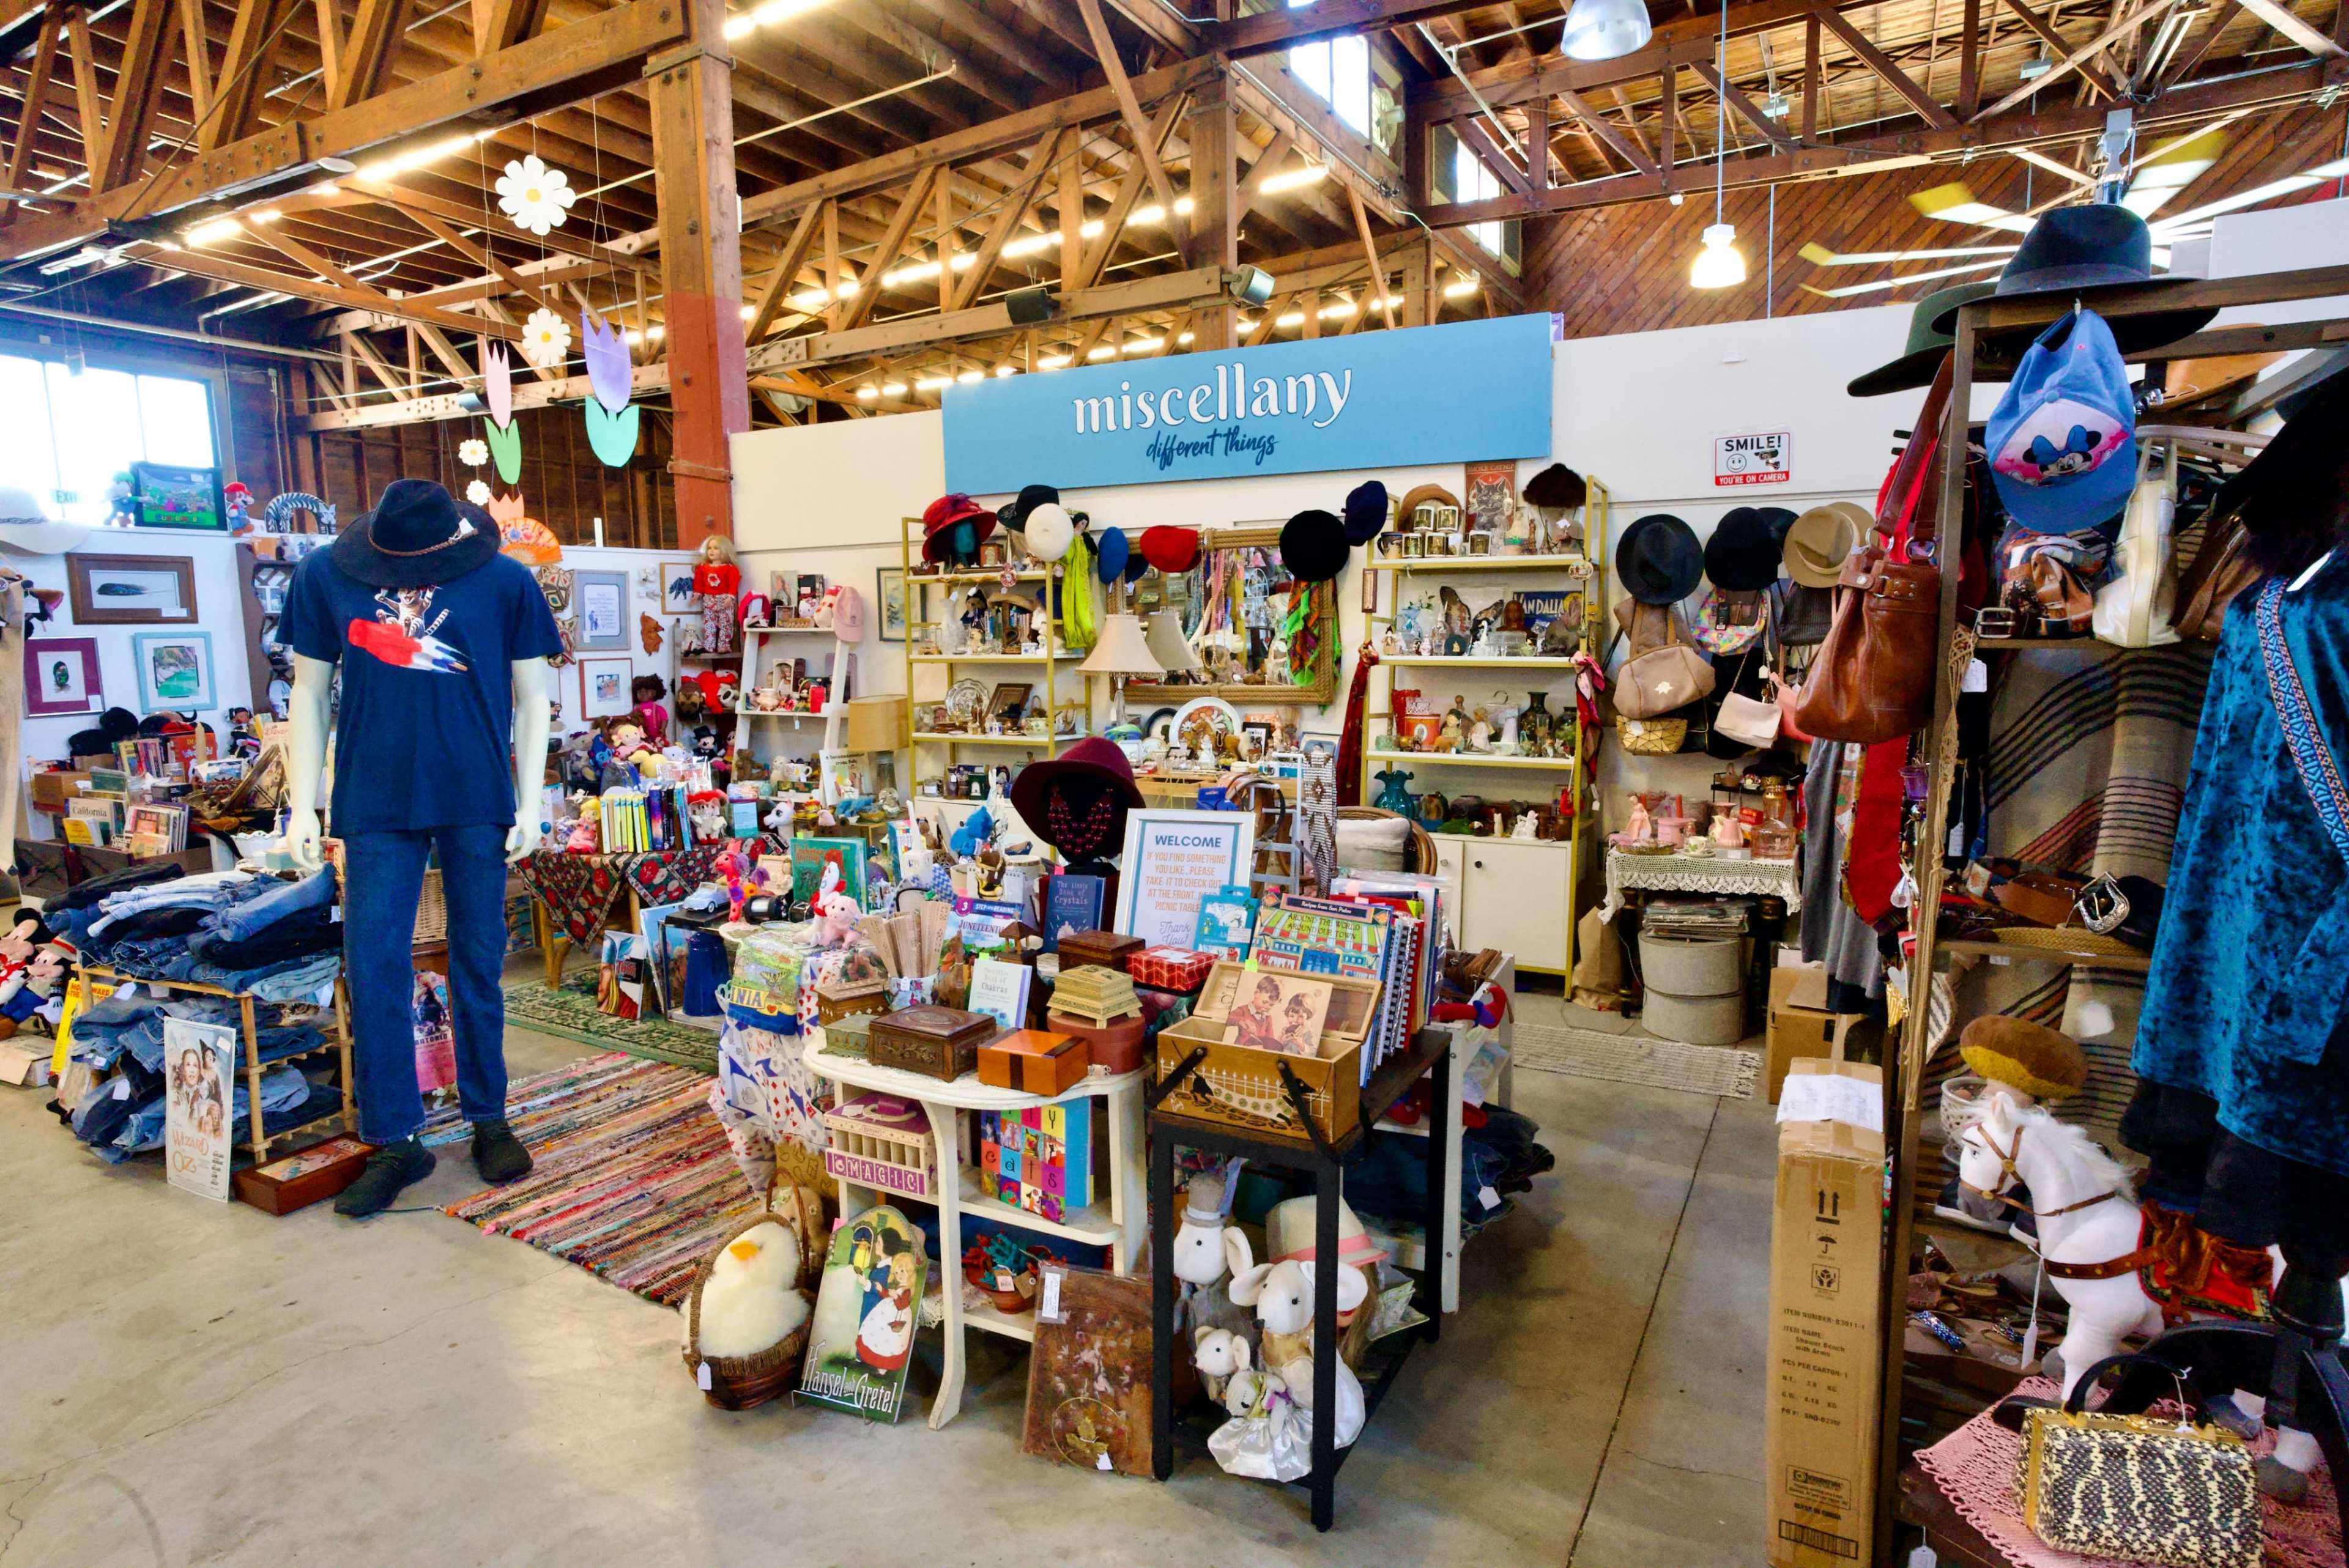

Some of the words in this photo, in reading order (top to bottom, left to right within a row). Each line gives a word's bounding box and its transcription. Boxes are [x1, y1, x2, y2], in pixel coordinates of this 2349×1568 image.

[1072, 362, 1352, 435] miscellany
[1146, 429, 1222, 471] different
[1223, 425, 1278, 465] things
[1724, 435, 1781, 452] SMILE!
[1720, 475, 1744, 485] YOU'RE
[1759, 473, 1787, 482] CAMERA
[72, 805, 107, 818] California
[1155, 835, 1222, 848] WELCOME
[1147, 852, 1153, 861] IF
[1155, 852, 1168, 862] YOU
[1170, 852, 1185, 862] FIND
[1186, 854, 1226, 864] SOMETHING
[1155, 865, 1168, 874] YOU
[1190, 866, 1215, 876] PLEASE
[1146, 876, 1162, 886] TAKE
[1166, 877, 1173, 886] IT
[1174, 877, 1183, 886] TO
[1184, 878, 1207, 887] CHECK
[1208, 879, 1222, 887] OUT
[1147, 889, 1156, 898] AT
[1158, 889, 1171, 898] THE
[962, 901, 968, 911] 3
[1055, 895, 1088, 905] Crystals
[1155, 901, 1178, 911] PICNIC
[1159, 920, 1192, 934] Thank
[1288, 912, 1316, 923] AROUND
[1319, 917, 1333, 926] THE
[1336, 920, 1360, 931] WORLD
[1287, 923, 1316, 934] AROUND
[1318, 928, 1332, 937] OUR
[1335, 931, 1357, 939] TOWN
[1162, 933, 1189, 945] You!
[981, 982, 1008, 994] Chakras
[848, 1158, 915, 1191] MAGIC
[1784, 1308, 1800, 1317] ITEM
[1783, 1325, 1800, 1334] ITEM
[1795, 1336, 1821, 1347] Shower
[1823, 1341, 1845, 1352] Bench
[1812, 1347, 1831, 1358] Arms
[1783, 1358, 1795, 1367] PCS
[1797, 1361, 1811, 1370] PER
[801, 1339, 847, 1398] Hansel
[854, 1373, 897, 1413] Gretel
